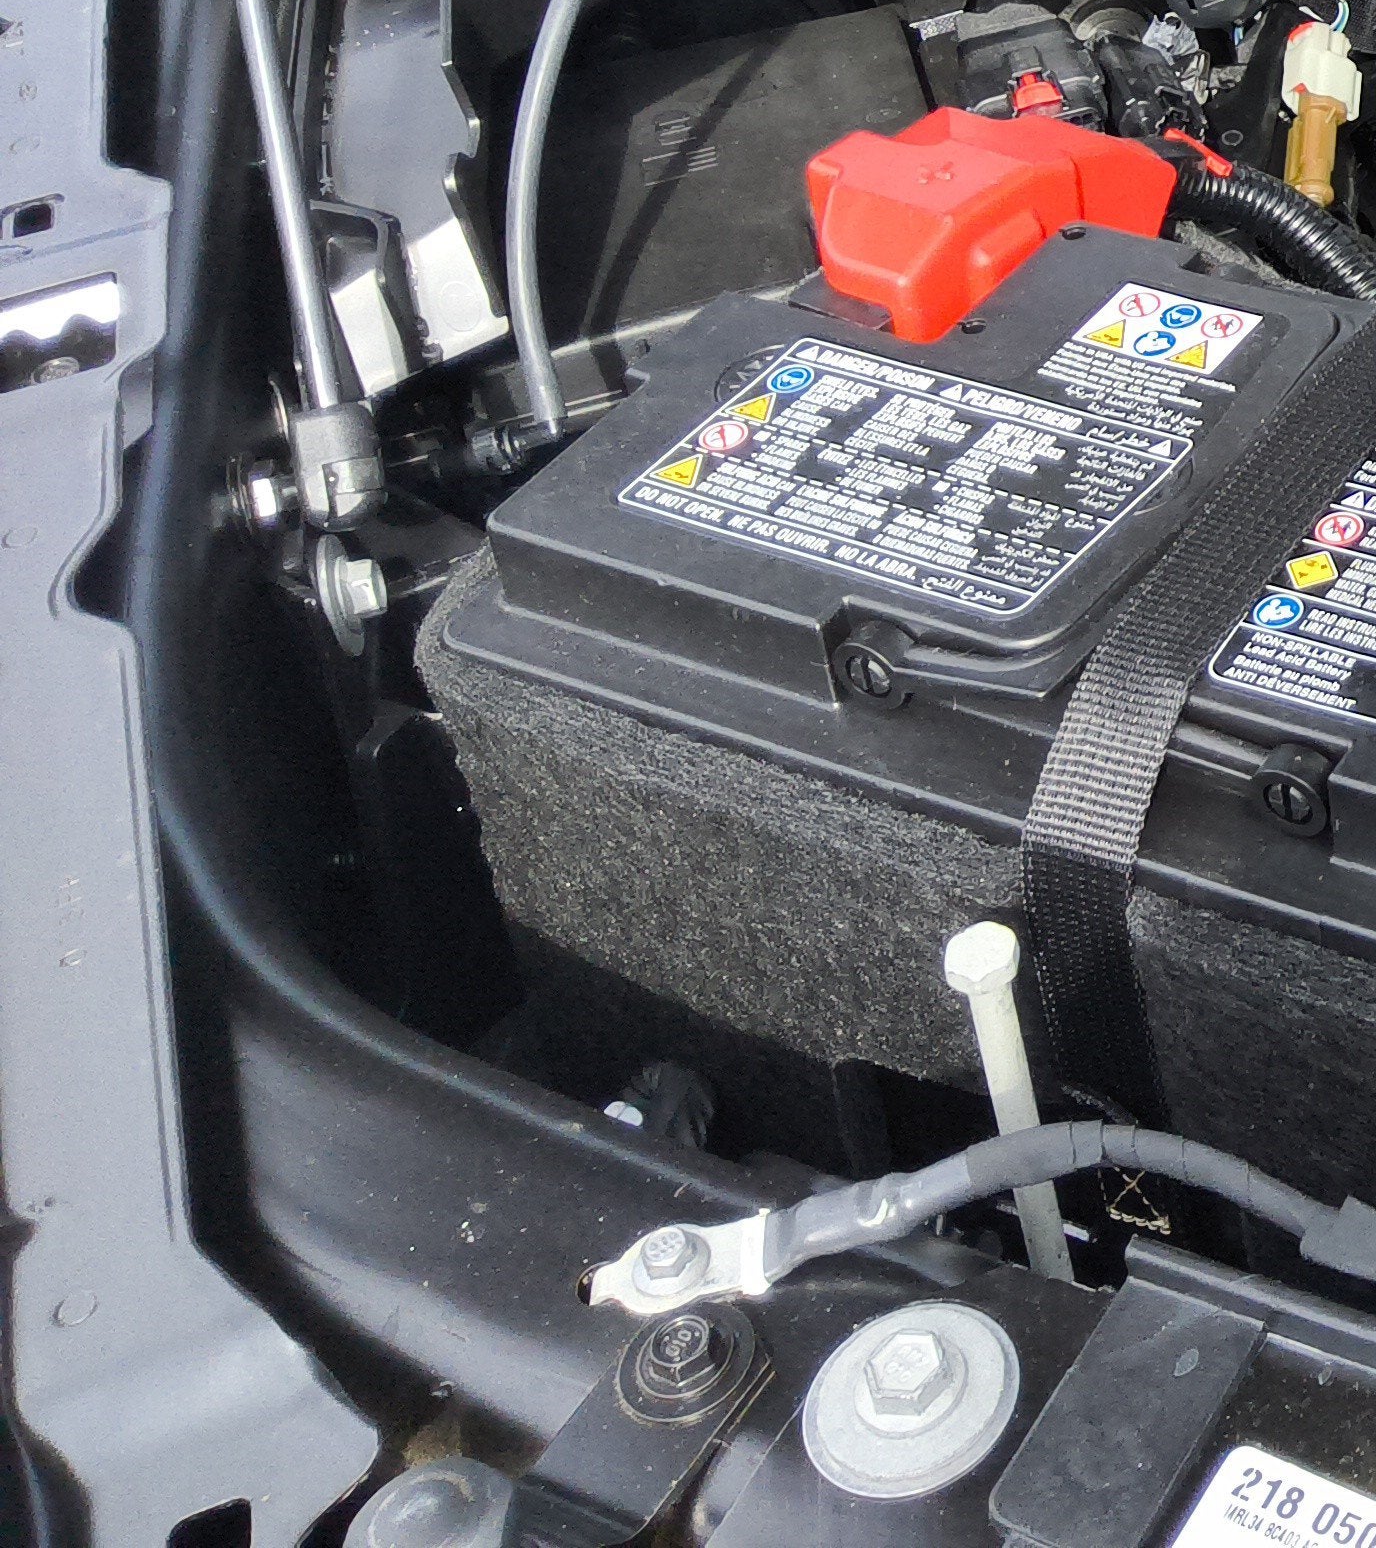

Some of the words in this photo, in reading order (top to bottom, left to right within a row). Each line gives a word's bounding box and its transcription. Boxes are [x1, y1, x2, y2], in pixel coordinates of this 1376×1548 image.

[813, 349, 938, 391] DANGER/POISON
[957, 388, 1086, 432] PELIGRO/VENENO
[631, 485, 662, 502] DO
[651, 491, 690, 511] NOT
[679, 500, 731, 523] OPEN.
[724, 514, 753, 530] NE
[743, 519, 781, 538] PAS
[770, 526, 837, 554] OUVRIR.
[831, 544, 862, 561] NO
[852, 550, 882, 567] LA
[871, 556, 925, 580] ABRA.
[1305, 608, 1339, 626] READ
[1323, 587, 1367, 607] MEDICAL
[1249, 631, 1358, 668] NON-SPILLABLE
[1296, 619, 1327, 635] LIRE
[1320, 625, 1346, 641] LES
[1231, 653, 1285, 676] Batterie
[1280, 668, 1301, 681] au
[1295, 671, 1344, 694] plomb
[1241, 641, 1277, 659] Lead
[1273, 650, 1307, 667] Acid
[1301, 658, 1353, 681] Battery
[1221, 665, 1258, 683] ANTI
[1253, 673, 1359, 711] DÉVERSEMENT
[1229, 1463, 1306, 1523] 218
